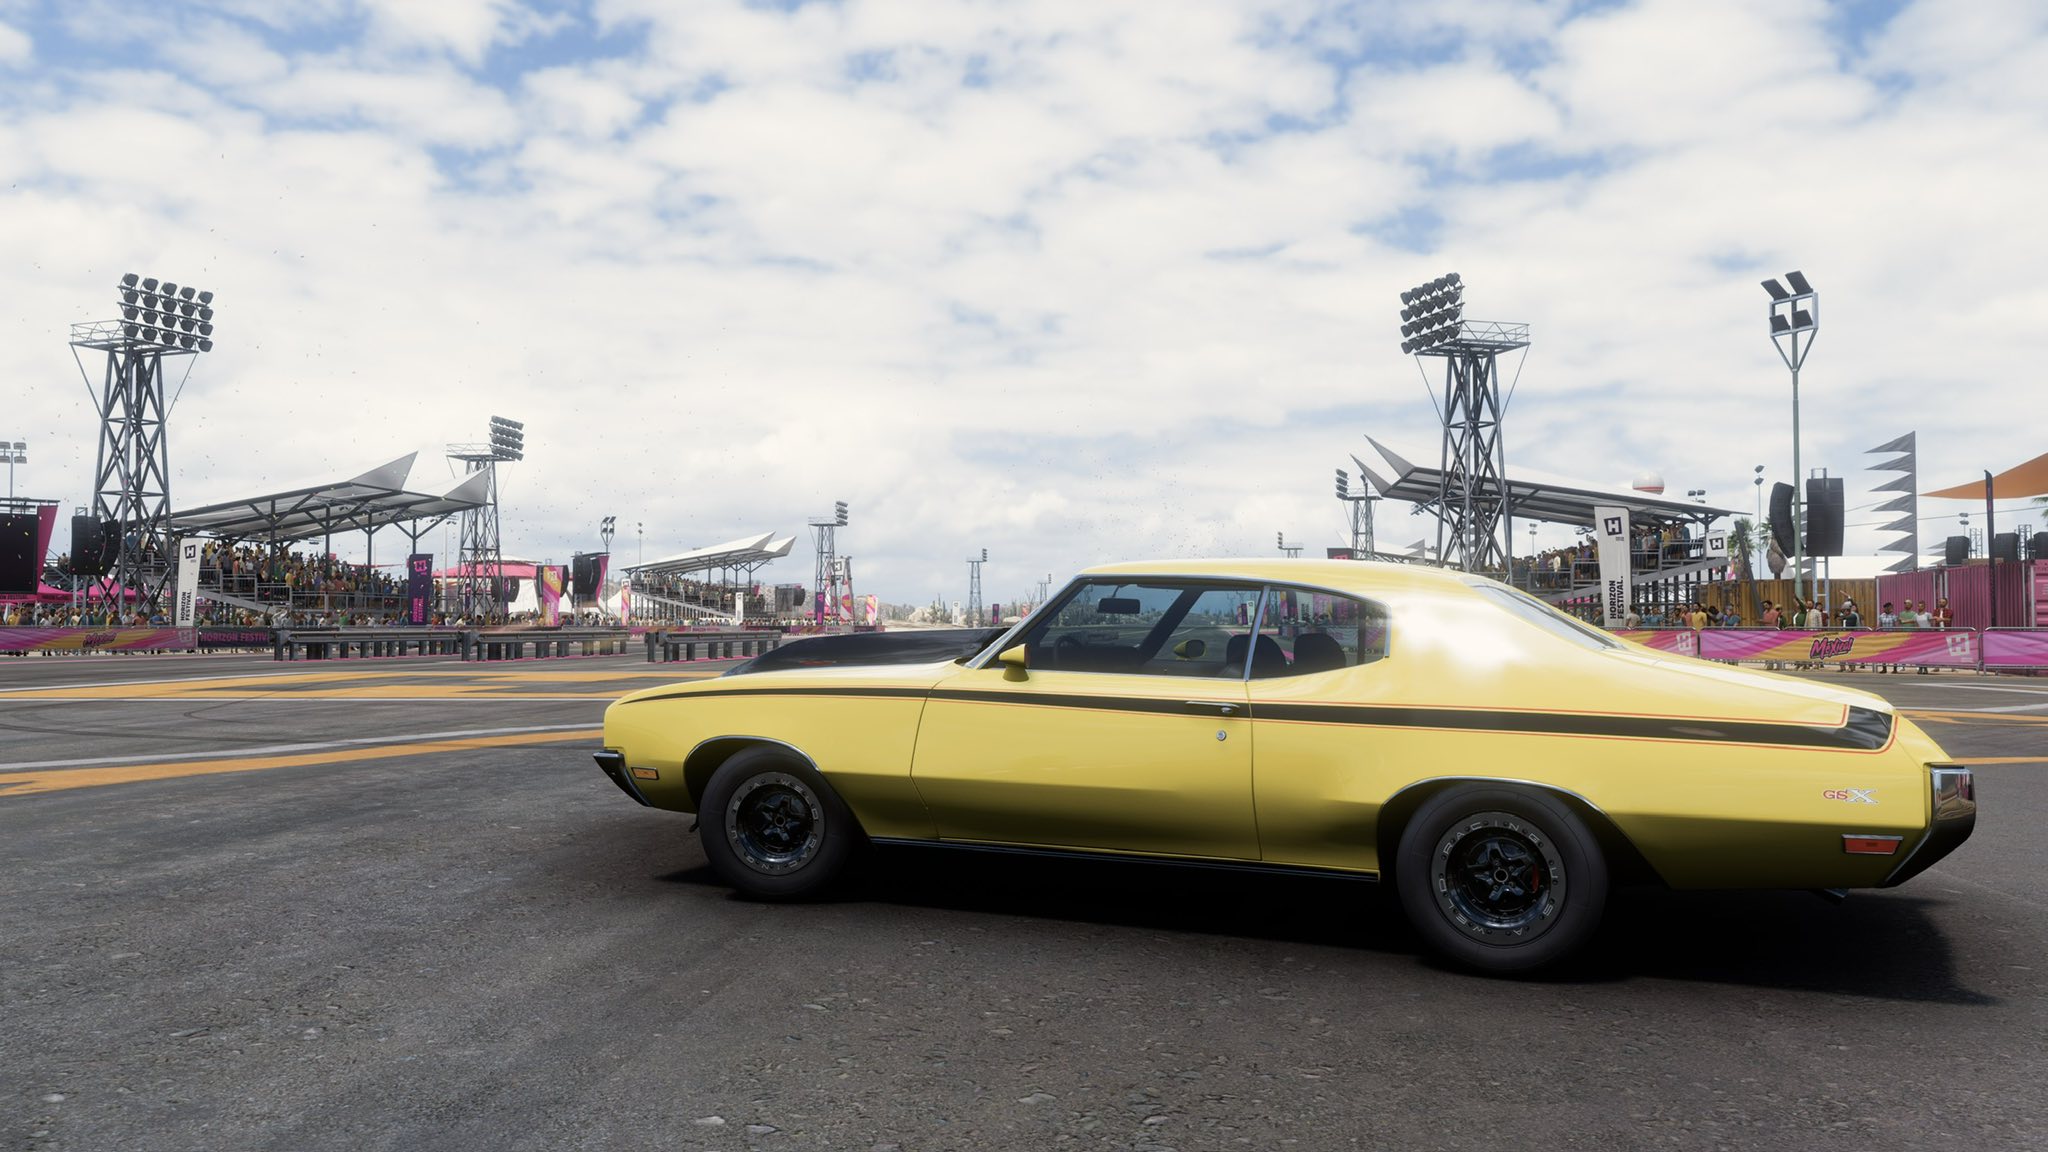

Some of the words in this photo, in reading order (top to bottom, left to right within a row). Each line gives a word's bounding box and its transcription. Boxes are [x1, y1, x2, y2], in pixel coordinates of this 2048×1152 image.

[201, 631, 238, 642] HORIZON
[1823, 788, 1878, 804] GSX
[1442, 820, 1541, 855] RACING
